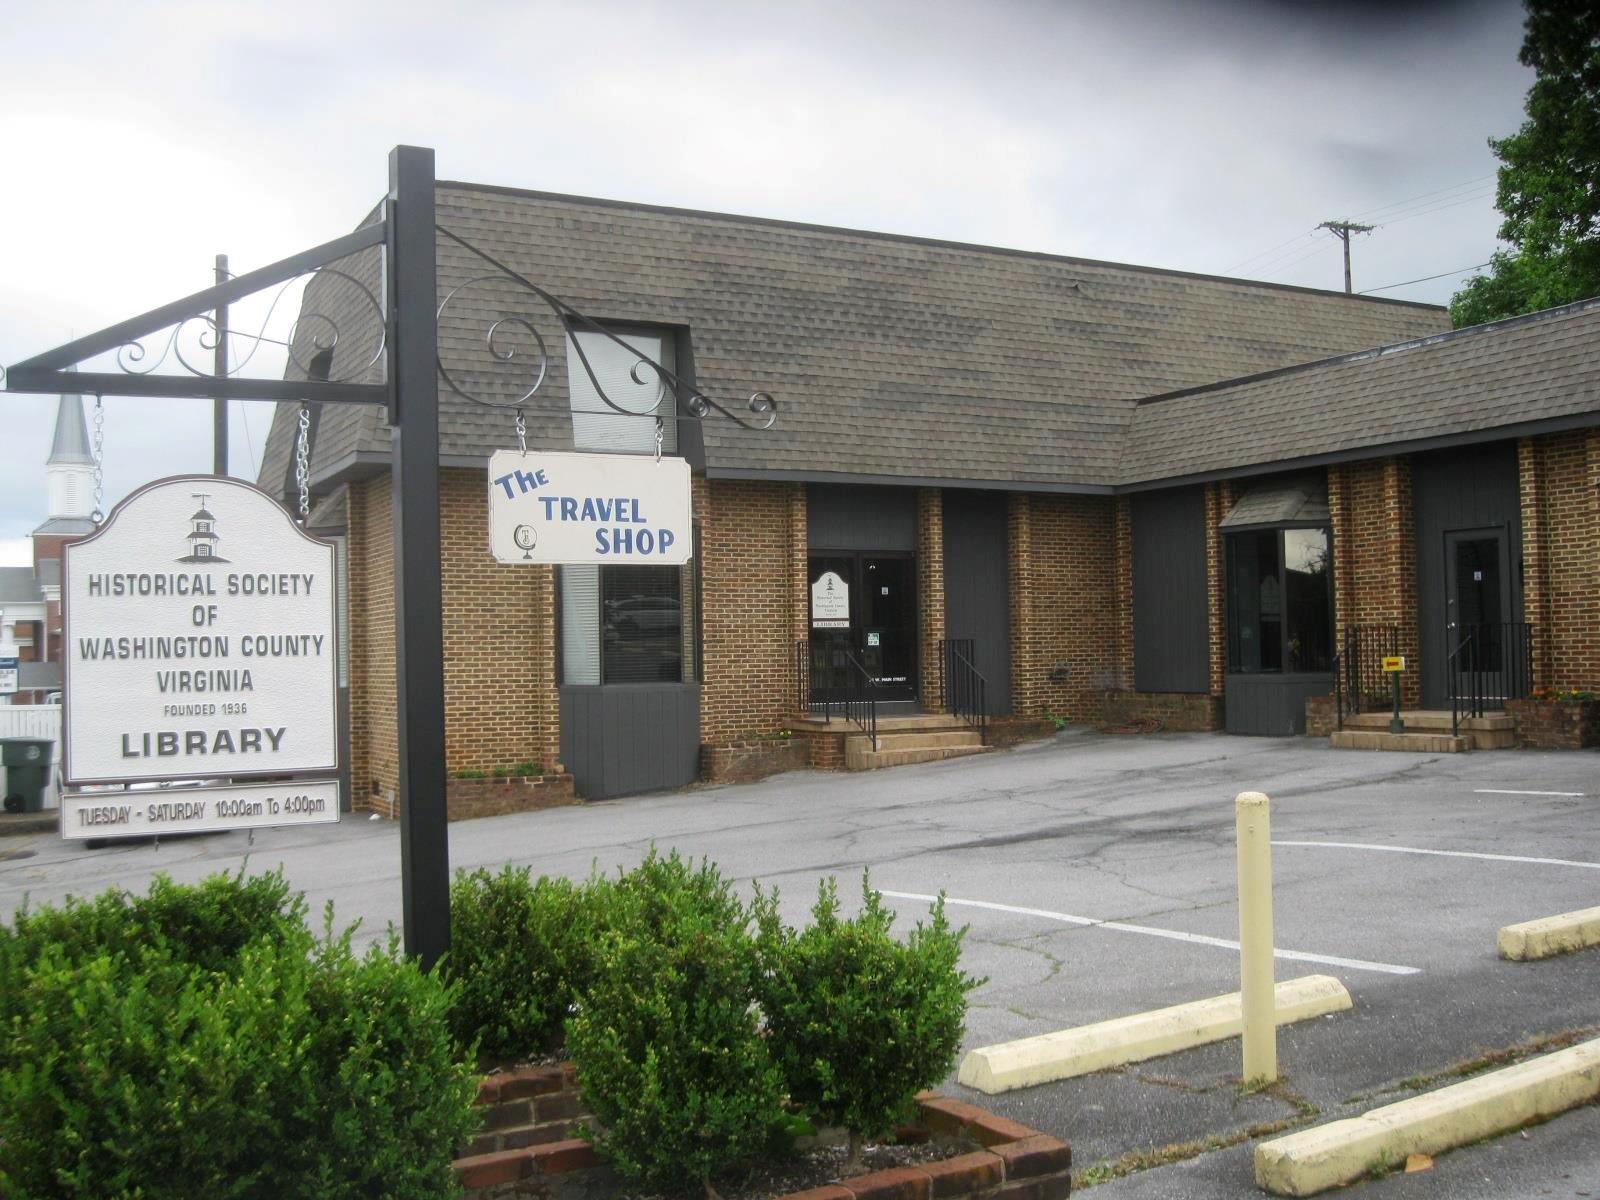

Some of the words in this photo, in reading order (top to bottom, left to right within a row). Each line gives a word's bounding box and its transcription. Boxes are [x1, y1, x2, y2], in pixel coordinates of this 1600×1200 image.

[538, 496, 647, 523] TRAVEL
[595, 527, 675, 555] SHOP
[89, 573, 217, 596] HISTORICAL
[227, 573, 315, 596] SOCIETY
[192, 604, 218, 627] OF
[79, 636, 230, 660] WASHINGTON
[241, 634, 324, 658] COUNTY
[156, 669, 254, 693] VIRGINIA
[164, 703, 216, 717] FOUNDED
[221, 702, 247, 715] 1936
[122, 727, 286, 758] LIBRARY
[78, 805, 132, 827] TUESDAY
[147, 802, 206, 823] SATURDAY
[215, 799, 263, 818] 10:00am
[267, 798, 280, 814] To
[284, 796, 325, 816] 4:00pm
